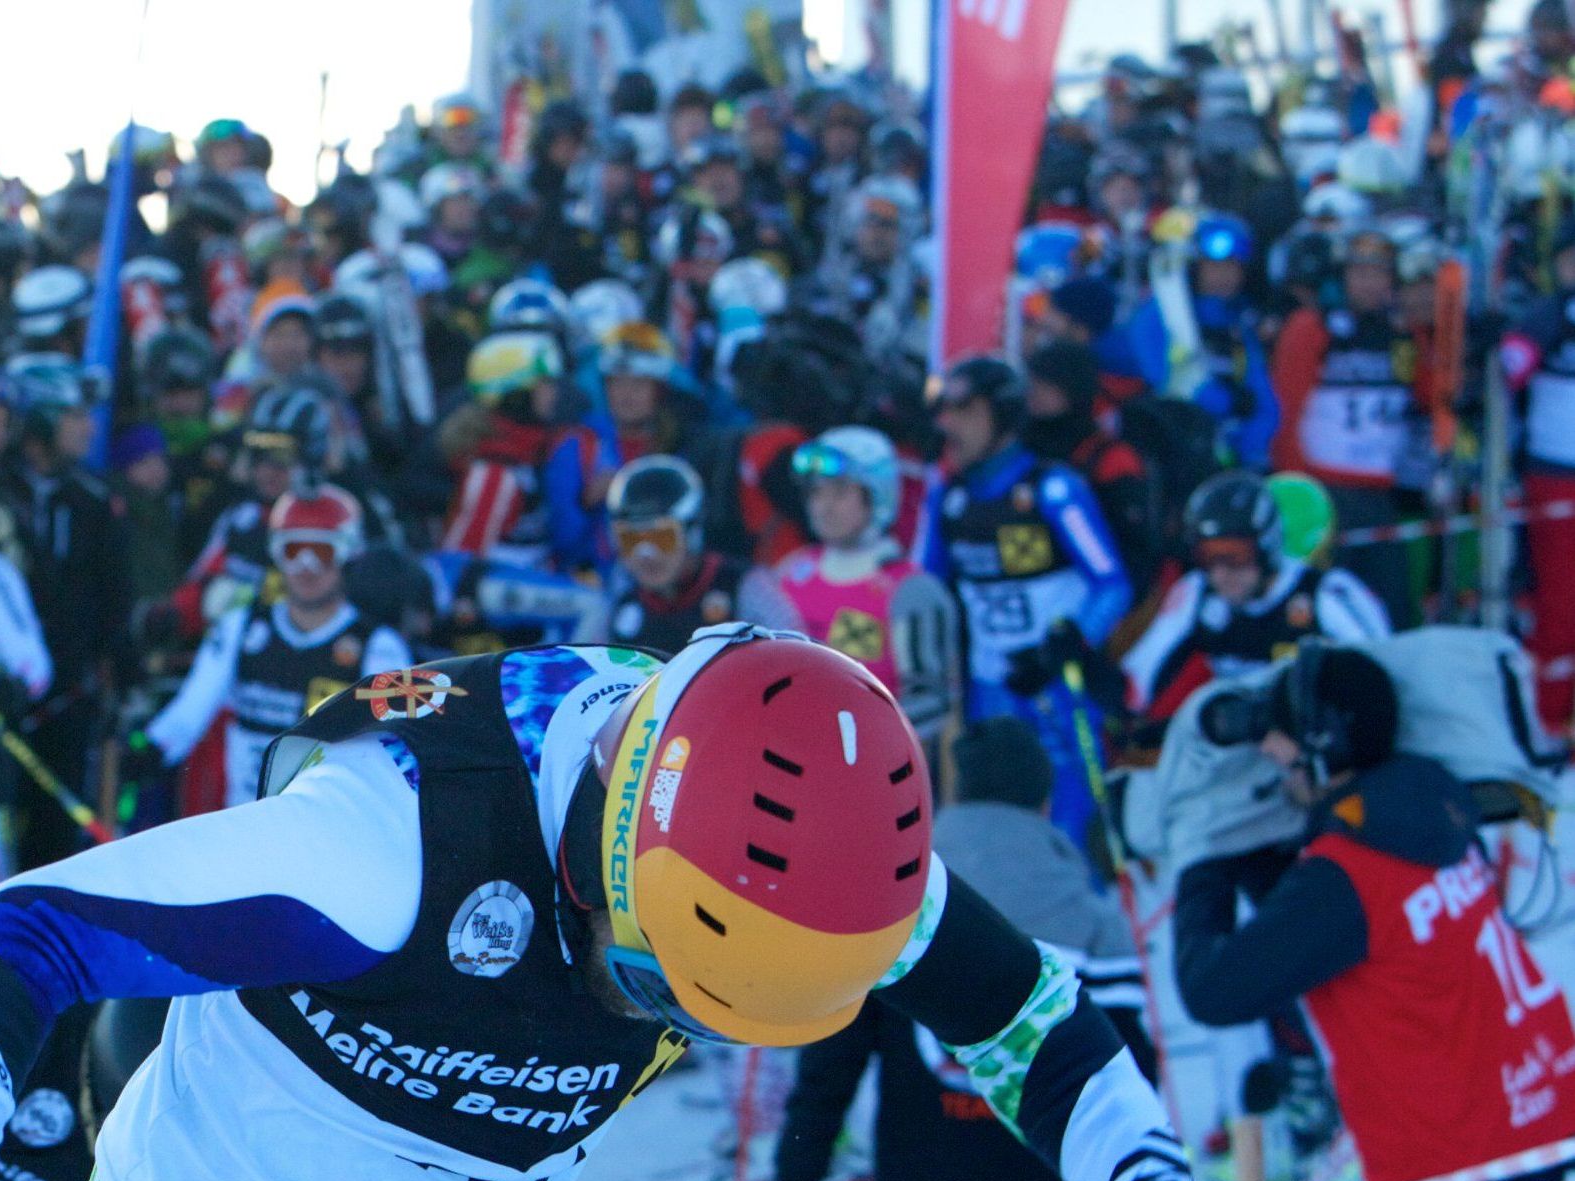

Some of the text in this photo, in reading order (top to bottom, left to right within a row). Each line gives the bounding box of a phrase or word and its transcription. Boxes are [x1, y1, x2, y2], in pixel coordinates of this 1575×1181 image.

[580, 683, 638, 715] ener
[611, 719, 659, 913] MARKER
[289, 990, 601, 1134] Meine Bank
